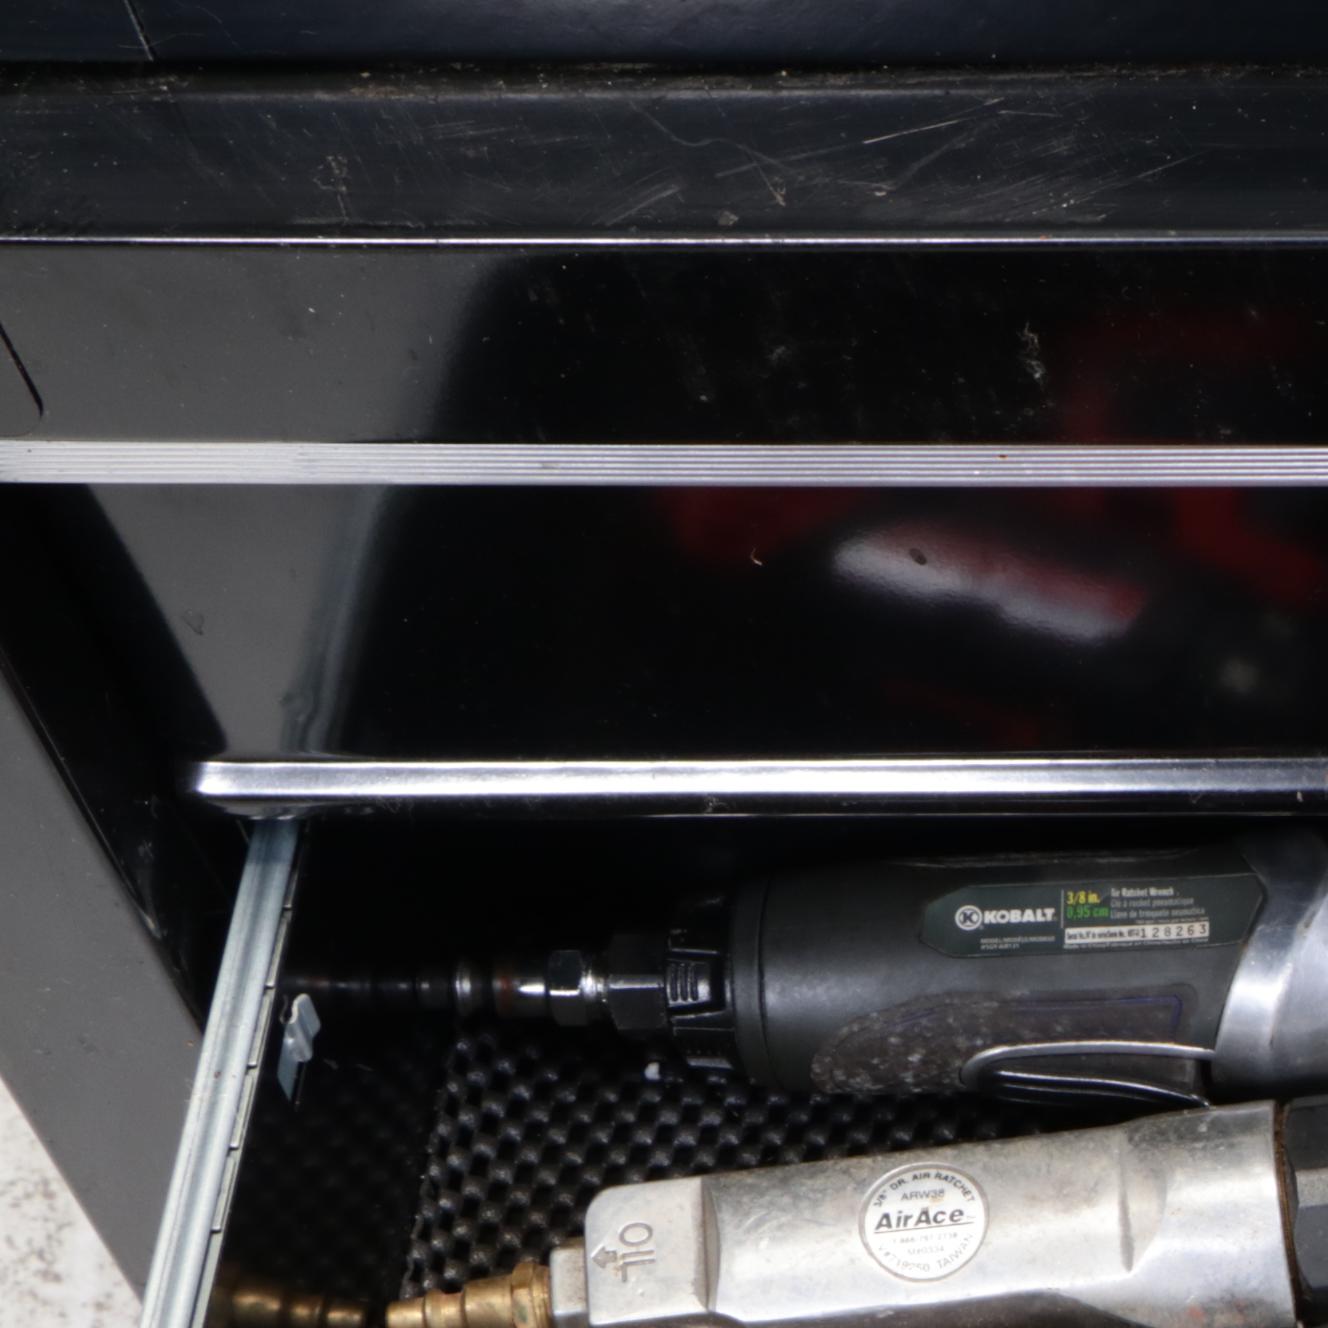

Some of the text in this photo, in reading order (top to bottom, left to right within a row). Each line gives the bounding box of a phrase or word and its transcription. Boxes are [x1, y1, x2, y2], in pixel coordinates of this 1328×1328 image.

[983, 908, 1055, 925] KOBALT
[912, 1172, 931, 1182] AIR
[935, 1171, 975, 1202] RATCHET
[874, 1206, 964, 1231] AirAce
